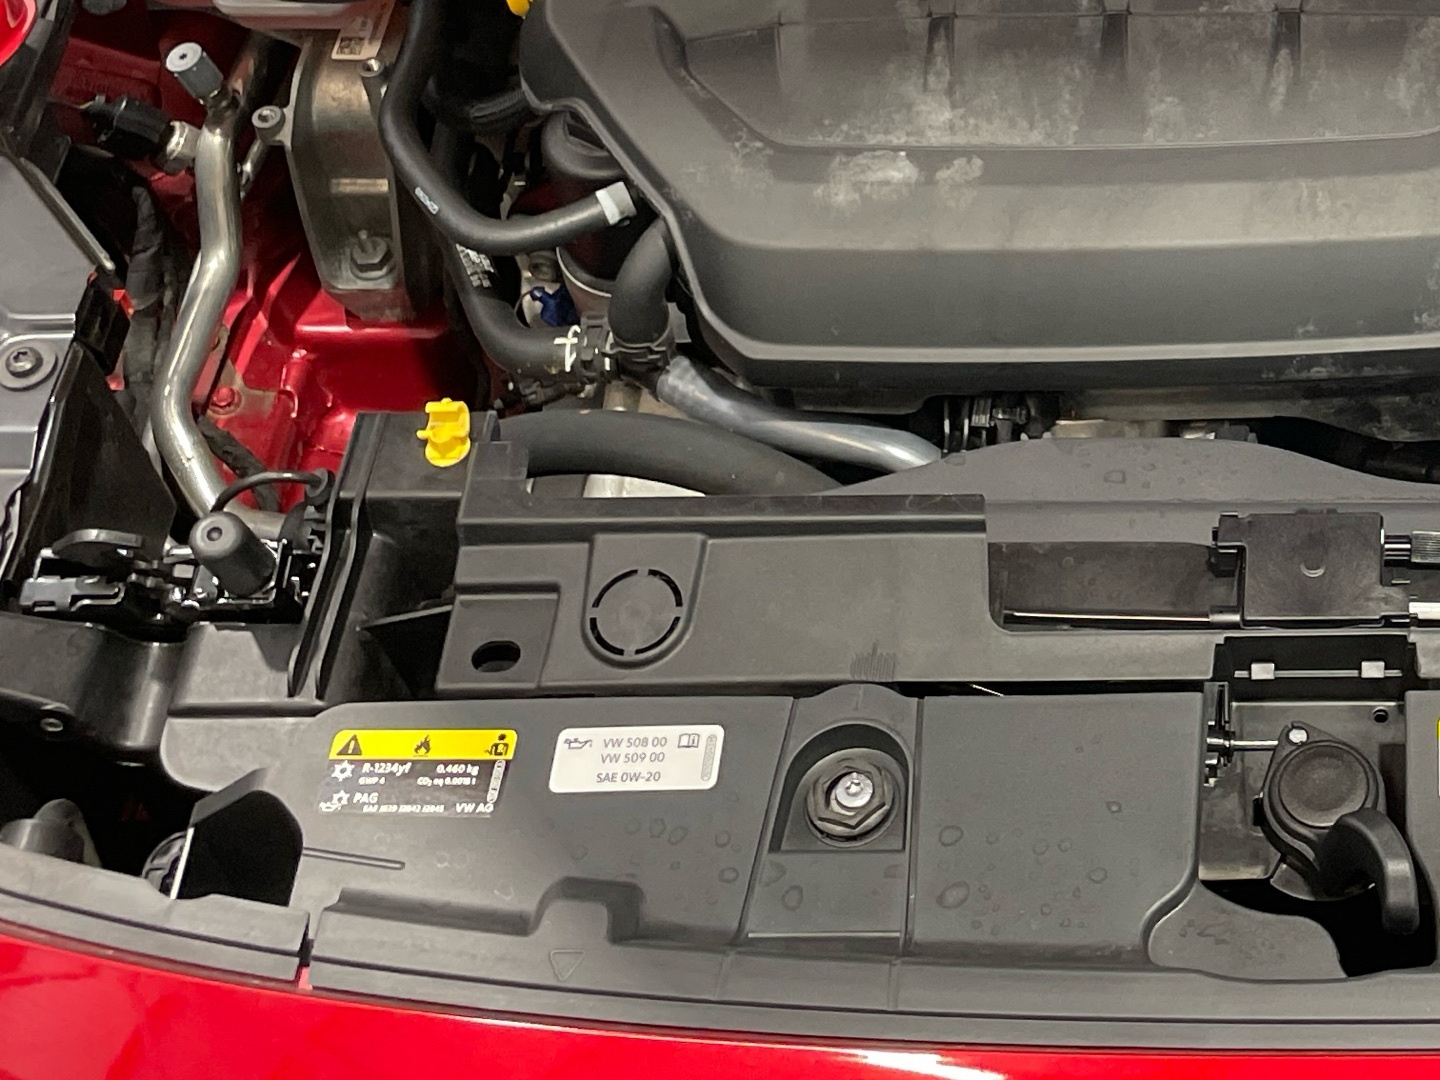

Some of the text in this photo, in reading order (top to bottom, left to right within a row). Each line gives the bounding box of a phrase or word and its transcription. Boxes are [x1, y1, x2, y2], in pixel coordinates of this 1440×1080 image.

[604, 736, 668, 748] VW 508 00
[601, 752, 666, 763] VW 509 00
[362, 762, 412, 776] R-1234yf
[467, 764, 479, 775] kg
[596, 771, 661, 783] SAE 0W-20
[353, 792, 379, 803] PAG
[456, 802, 494, 813] VW AG
